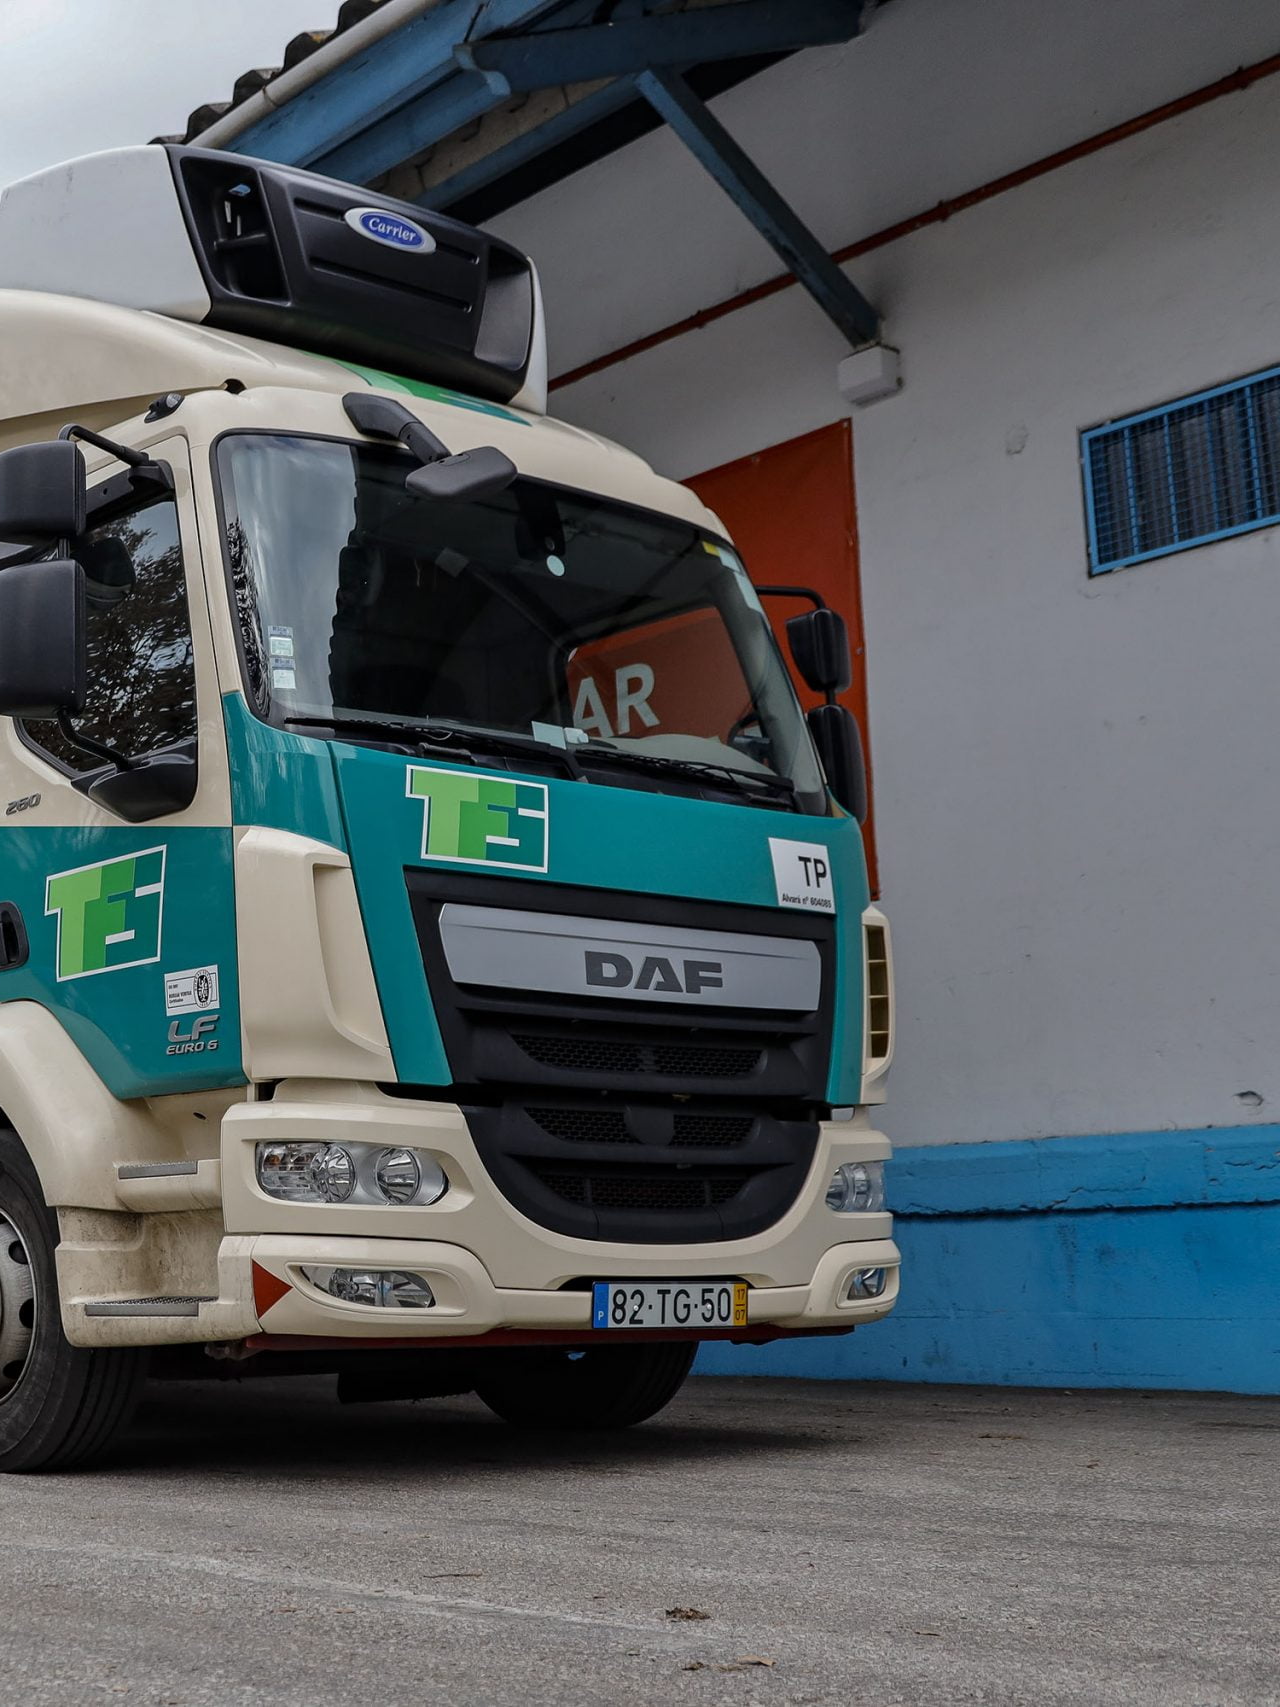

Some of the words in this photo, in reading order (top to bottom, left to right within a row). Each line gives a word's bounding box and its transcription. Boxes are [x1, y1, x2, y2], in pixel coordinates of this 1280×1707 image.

[369, 217, 416, 242] Carrier
[5, 793, 41, 816] 260
[797, 856, 827, 888] TP
[585, 950, 723, 994] DAF
[168, 1014, 220, 1042] LF
[166, 1041, 205, 1055] EURO
[207, 1039, 218, 1050] 6
[736, 1289, 745, 1300] 17
[598, 1310, 604, 1320] P
[735, 1310, 745, 1320] 07
